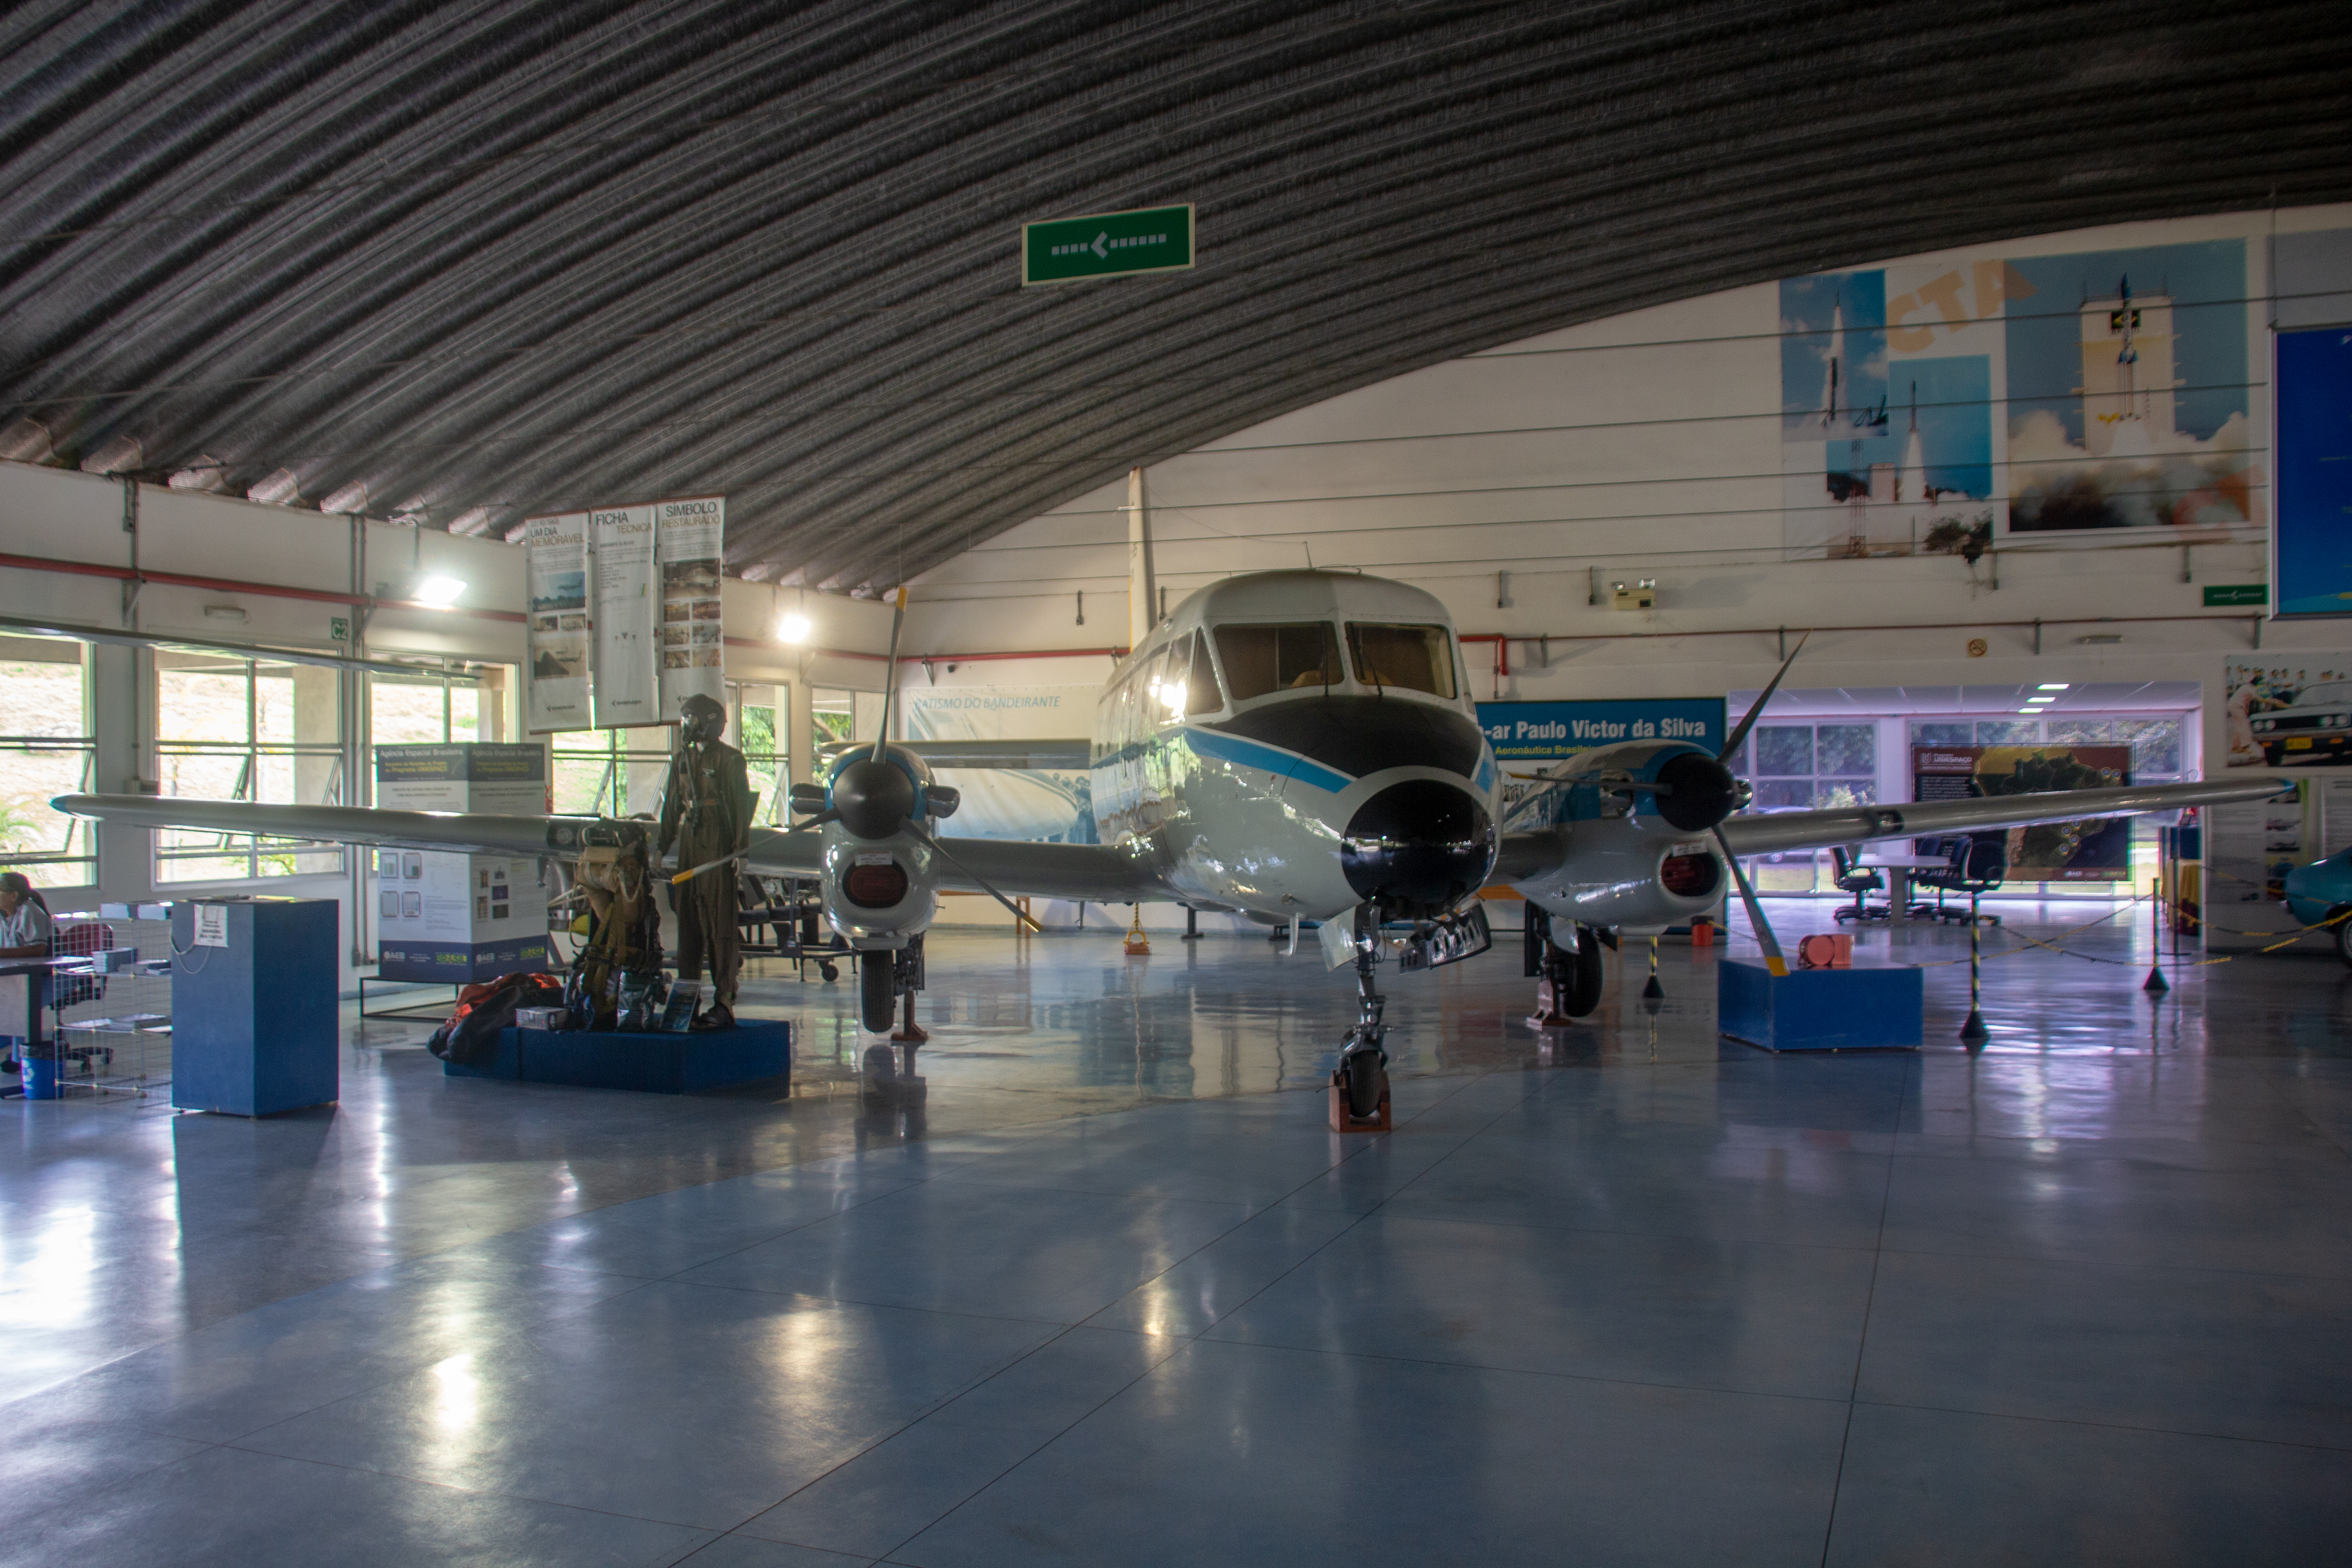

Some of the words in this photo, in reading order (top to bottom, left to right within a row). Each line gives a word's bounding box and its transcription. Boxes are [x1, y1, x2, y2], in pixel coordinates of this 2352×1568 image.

[1886, 258, 2040, 353] CTA
[666, 501, 716, 517] SÍMBOLO
[596, 511, 628, 525] FICHA
[662, 514, 720, 529] RESTAURADO
[530, 528, 542, 538] UM
[544, 526, 558, 535] DIA
[616, 522, 652, 534] TÉCNICA
[531, 532, 585, 547] MEMORÁVEL
[332, 623, 347, 639] C2
[915, 697, 962, 709] BATISMO
[964, 697, 981, 709] DO
[984, 696, 1061, 709] BANDEIRANTE
[1516, 720, 1567, 740] Paulo
[1572, 719, 1627, 739] Victor
[1632, 718, 1655, 738] da
[1661, 717, 1706, 737] Silva
[380, 749, 403, 758] Agência
[405, 749, 431, 757] Espacial
[1494, 745, 1552, 755] Aeronáutica
[390, 951, 405, 960] AEB
